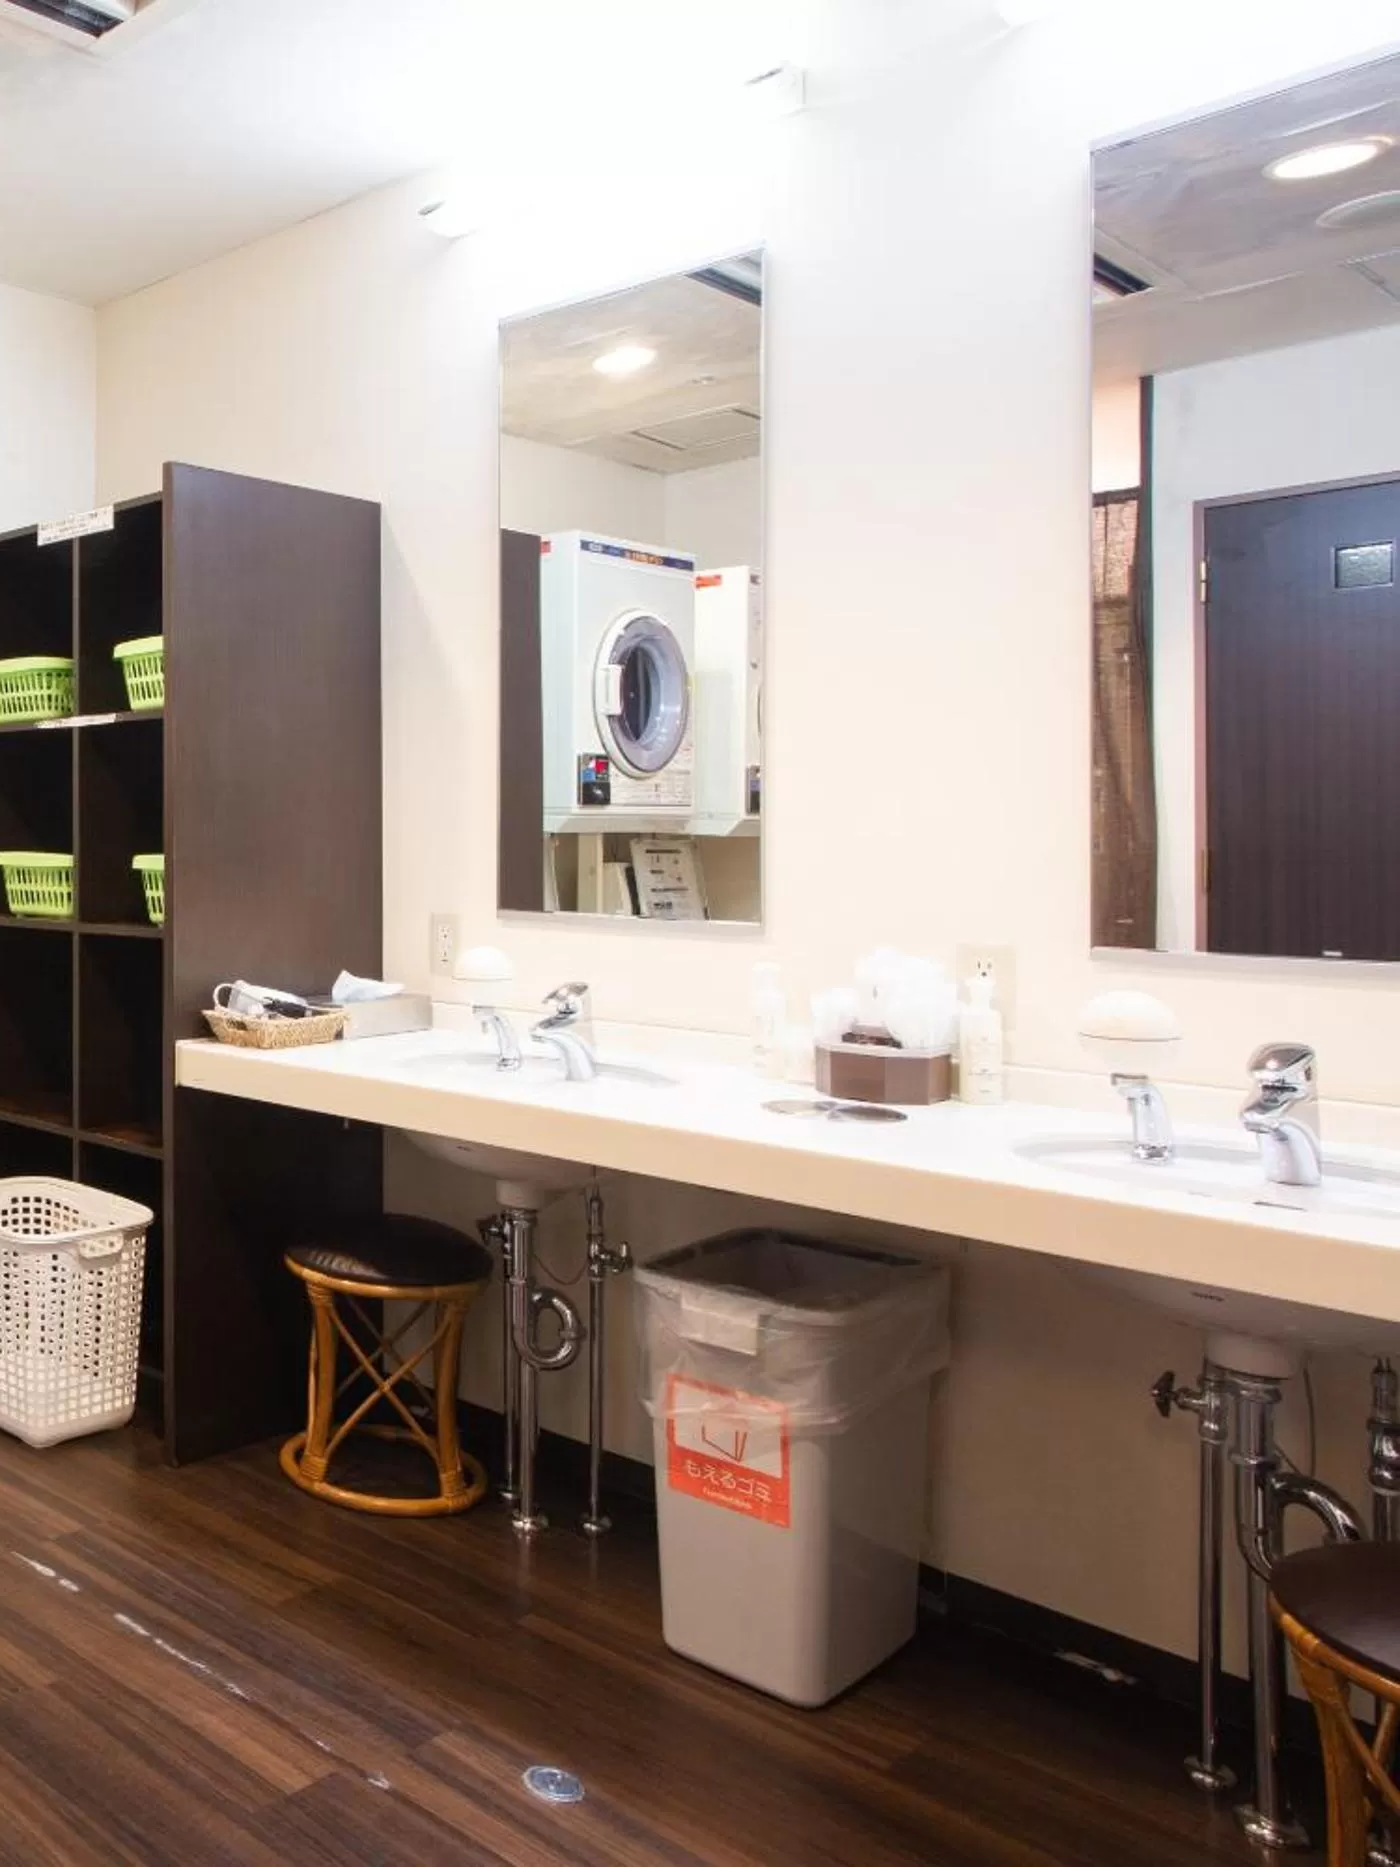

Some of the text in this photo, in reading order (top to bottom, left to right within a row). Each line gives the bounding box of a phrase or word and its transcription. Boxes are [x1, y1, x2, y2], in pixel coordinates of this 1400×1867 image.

[685, 1459, 772, 1503] もえるゴミ
